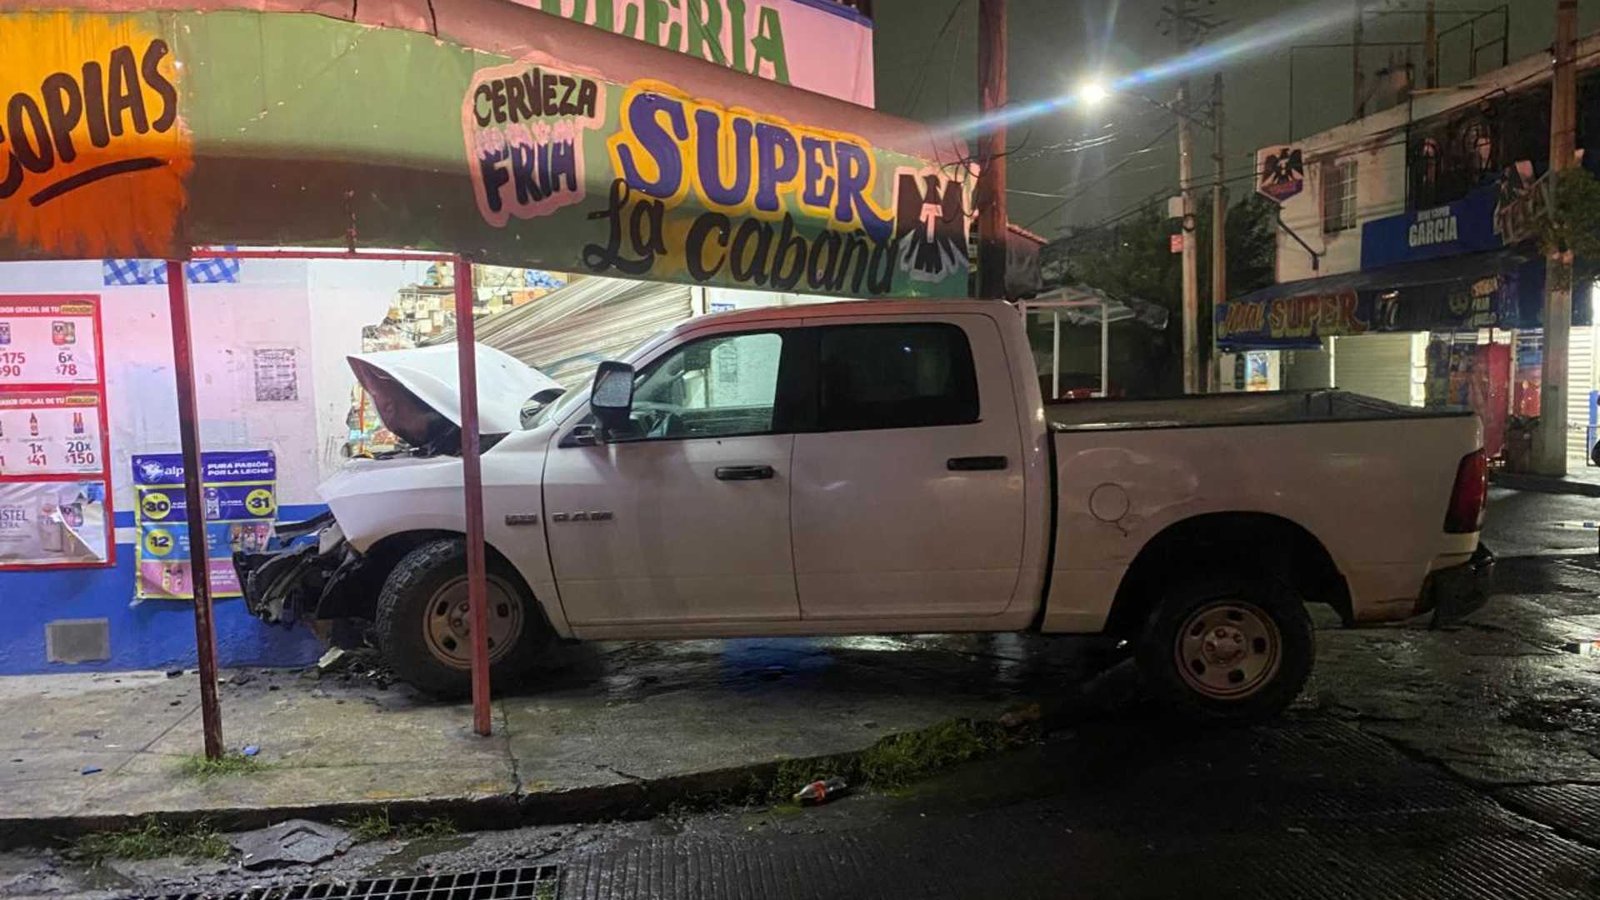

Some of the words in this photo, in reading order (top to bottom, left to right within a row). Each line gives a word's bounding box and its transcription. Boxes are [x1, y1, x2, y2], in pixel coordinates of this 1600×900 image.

[473, 68, 598, 127] CERVEZA
[616, 91, 897, 244] SUPER
[583, 178, 668, 274] La
[1408, 215, 1458, 247] GARCIA
[1269, 287, 1369, 337] SUPER
[58, 352, 73, 363] 6x
[55, 364, 78, 376] $78
[28, 443, 43, 454] 1x
[67, 442, 92, 453] 20x
[65, 453, 95, 464] $150
[0, 509, 28, 521] STEL
[552, 511, 613, 522] RAM
